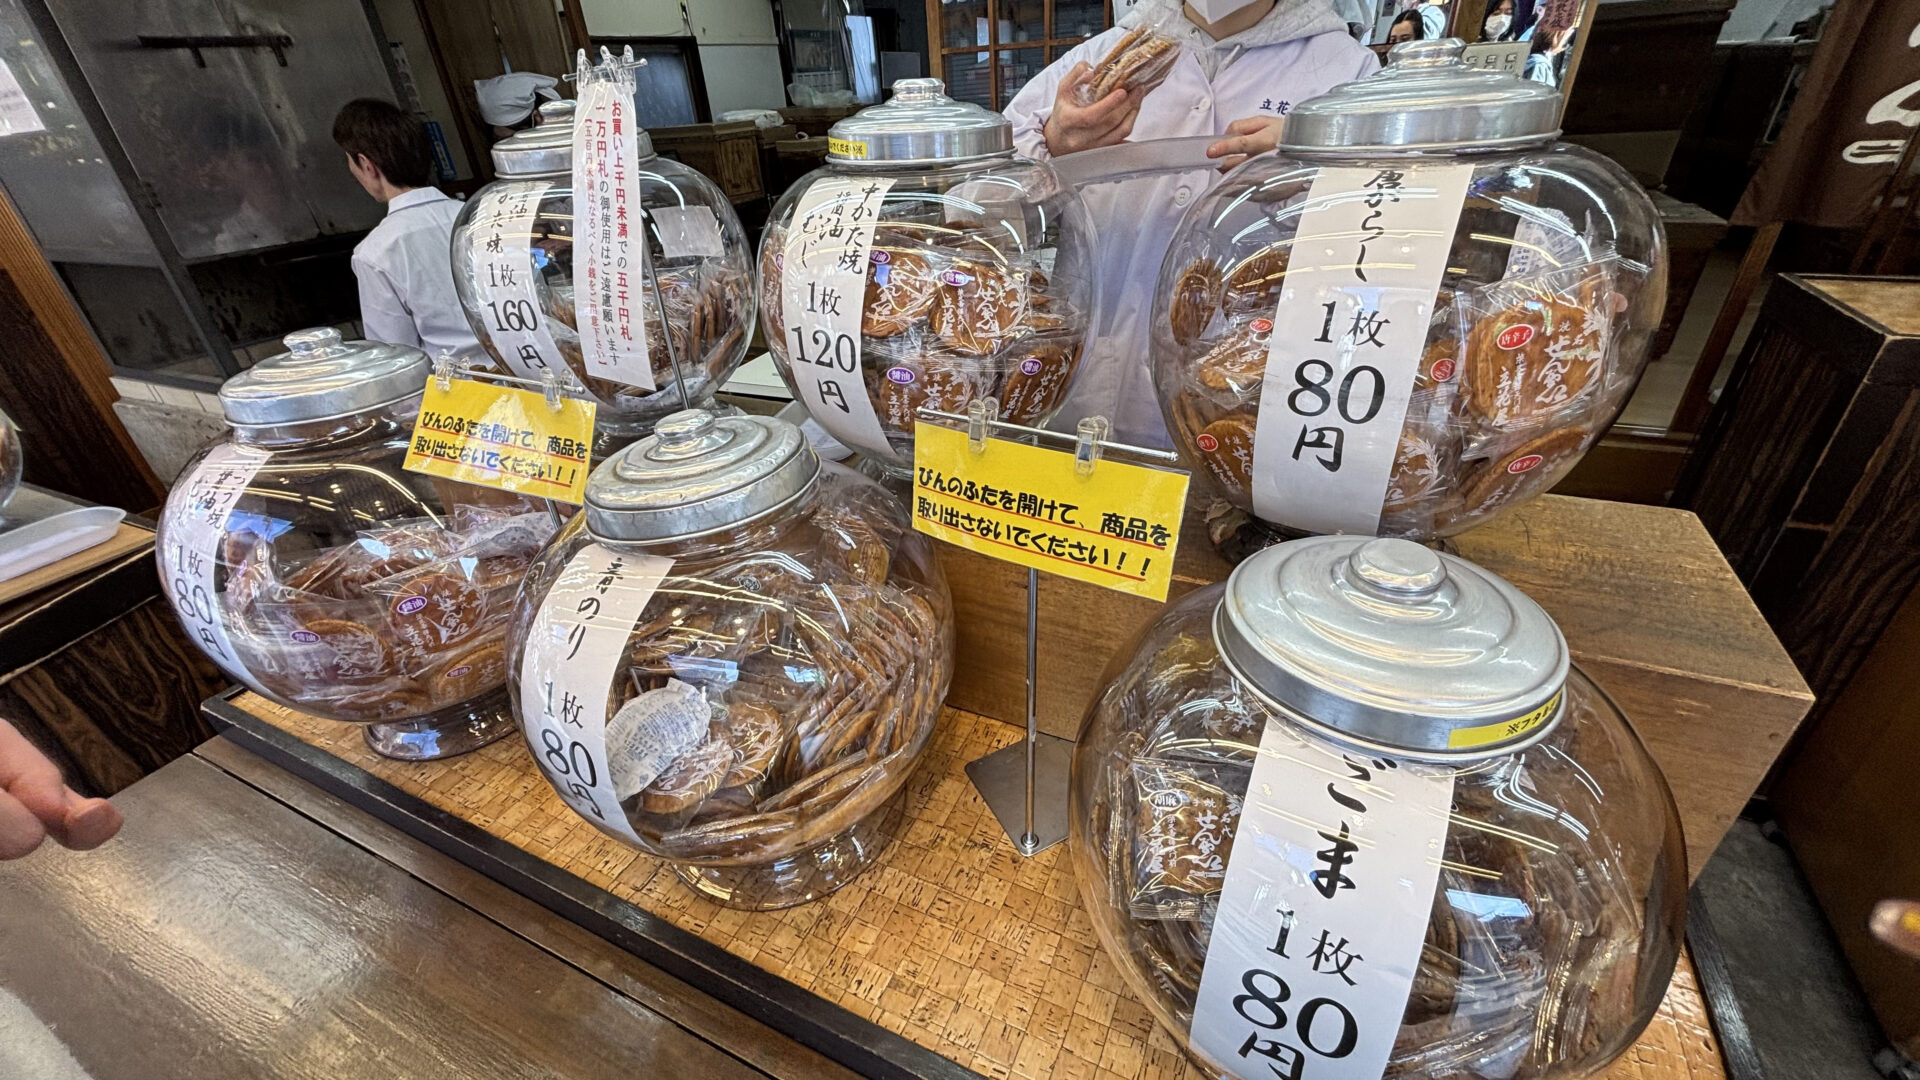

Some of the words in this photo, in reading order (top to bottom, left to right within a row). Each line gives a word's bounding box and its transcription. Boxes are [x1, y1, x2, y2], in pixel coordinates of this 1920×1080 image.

[1259, 98, 1291, 116] 立花
[488, 262, 517, 288] 1枚
[806, 281, 841, 316] 1枚
[488, 299, 538, 332] 160
[1313, 301, 1391, 348] 1枚
[516, 344, 547, 369] 円
[791, 326, 857, 374] 120
[817, 378, 850, 414] 円
[1287, 358, 1386, 425] 80
[1291, 423, 1346, 473] 円
[174, 544, 203, 578] 1枚
[174, 578, 214, 625] 80
[544, 681, 585, 729] 1枚
[541, 728, 598, 788] 80
[1310, 753, 1398, 899] ごま
[1266, 908, 1365, 986] 1枚
[1232, 968, 1359, 1059] 80
[1238, 1031, 1306, 1080] 円
